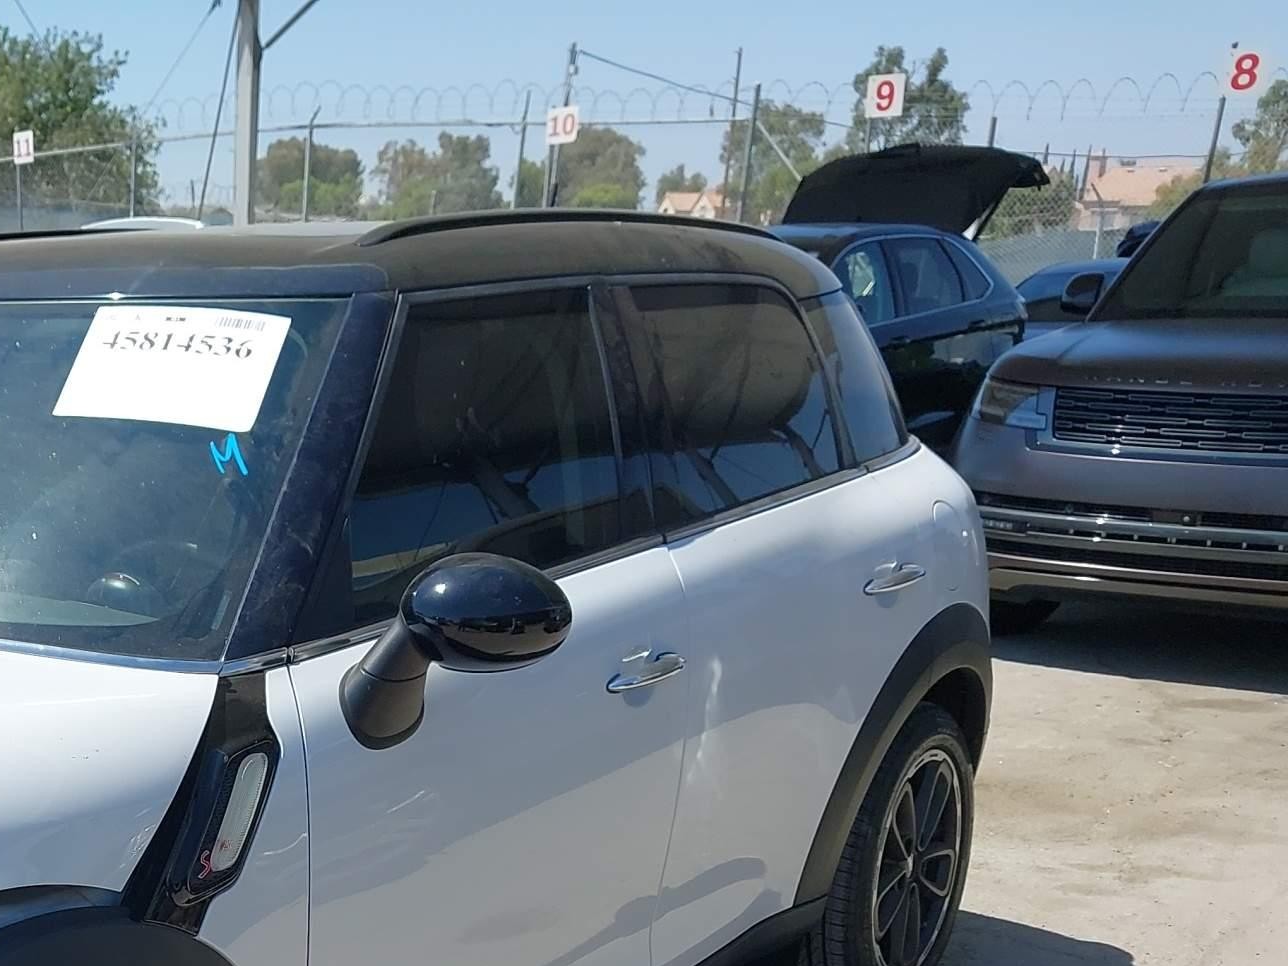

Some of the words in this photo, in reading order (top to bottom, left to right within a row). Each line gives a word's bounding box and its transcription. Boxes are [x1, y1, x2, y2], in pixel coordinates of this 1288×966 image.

[1231, 53, 1259, 90] 8
[876, 80, 894, 111] 9
[549, 113, 575, 137] 10
[102, 331, 253, 359] 45814536
